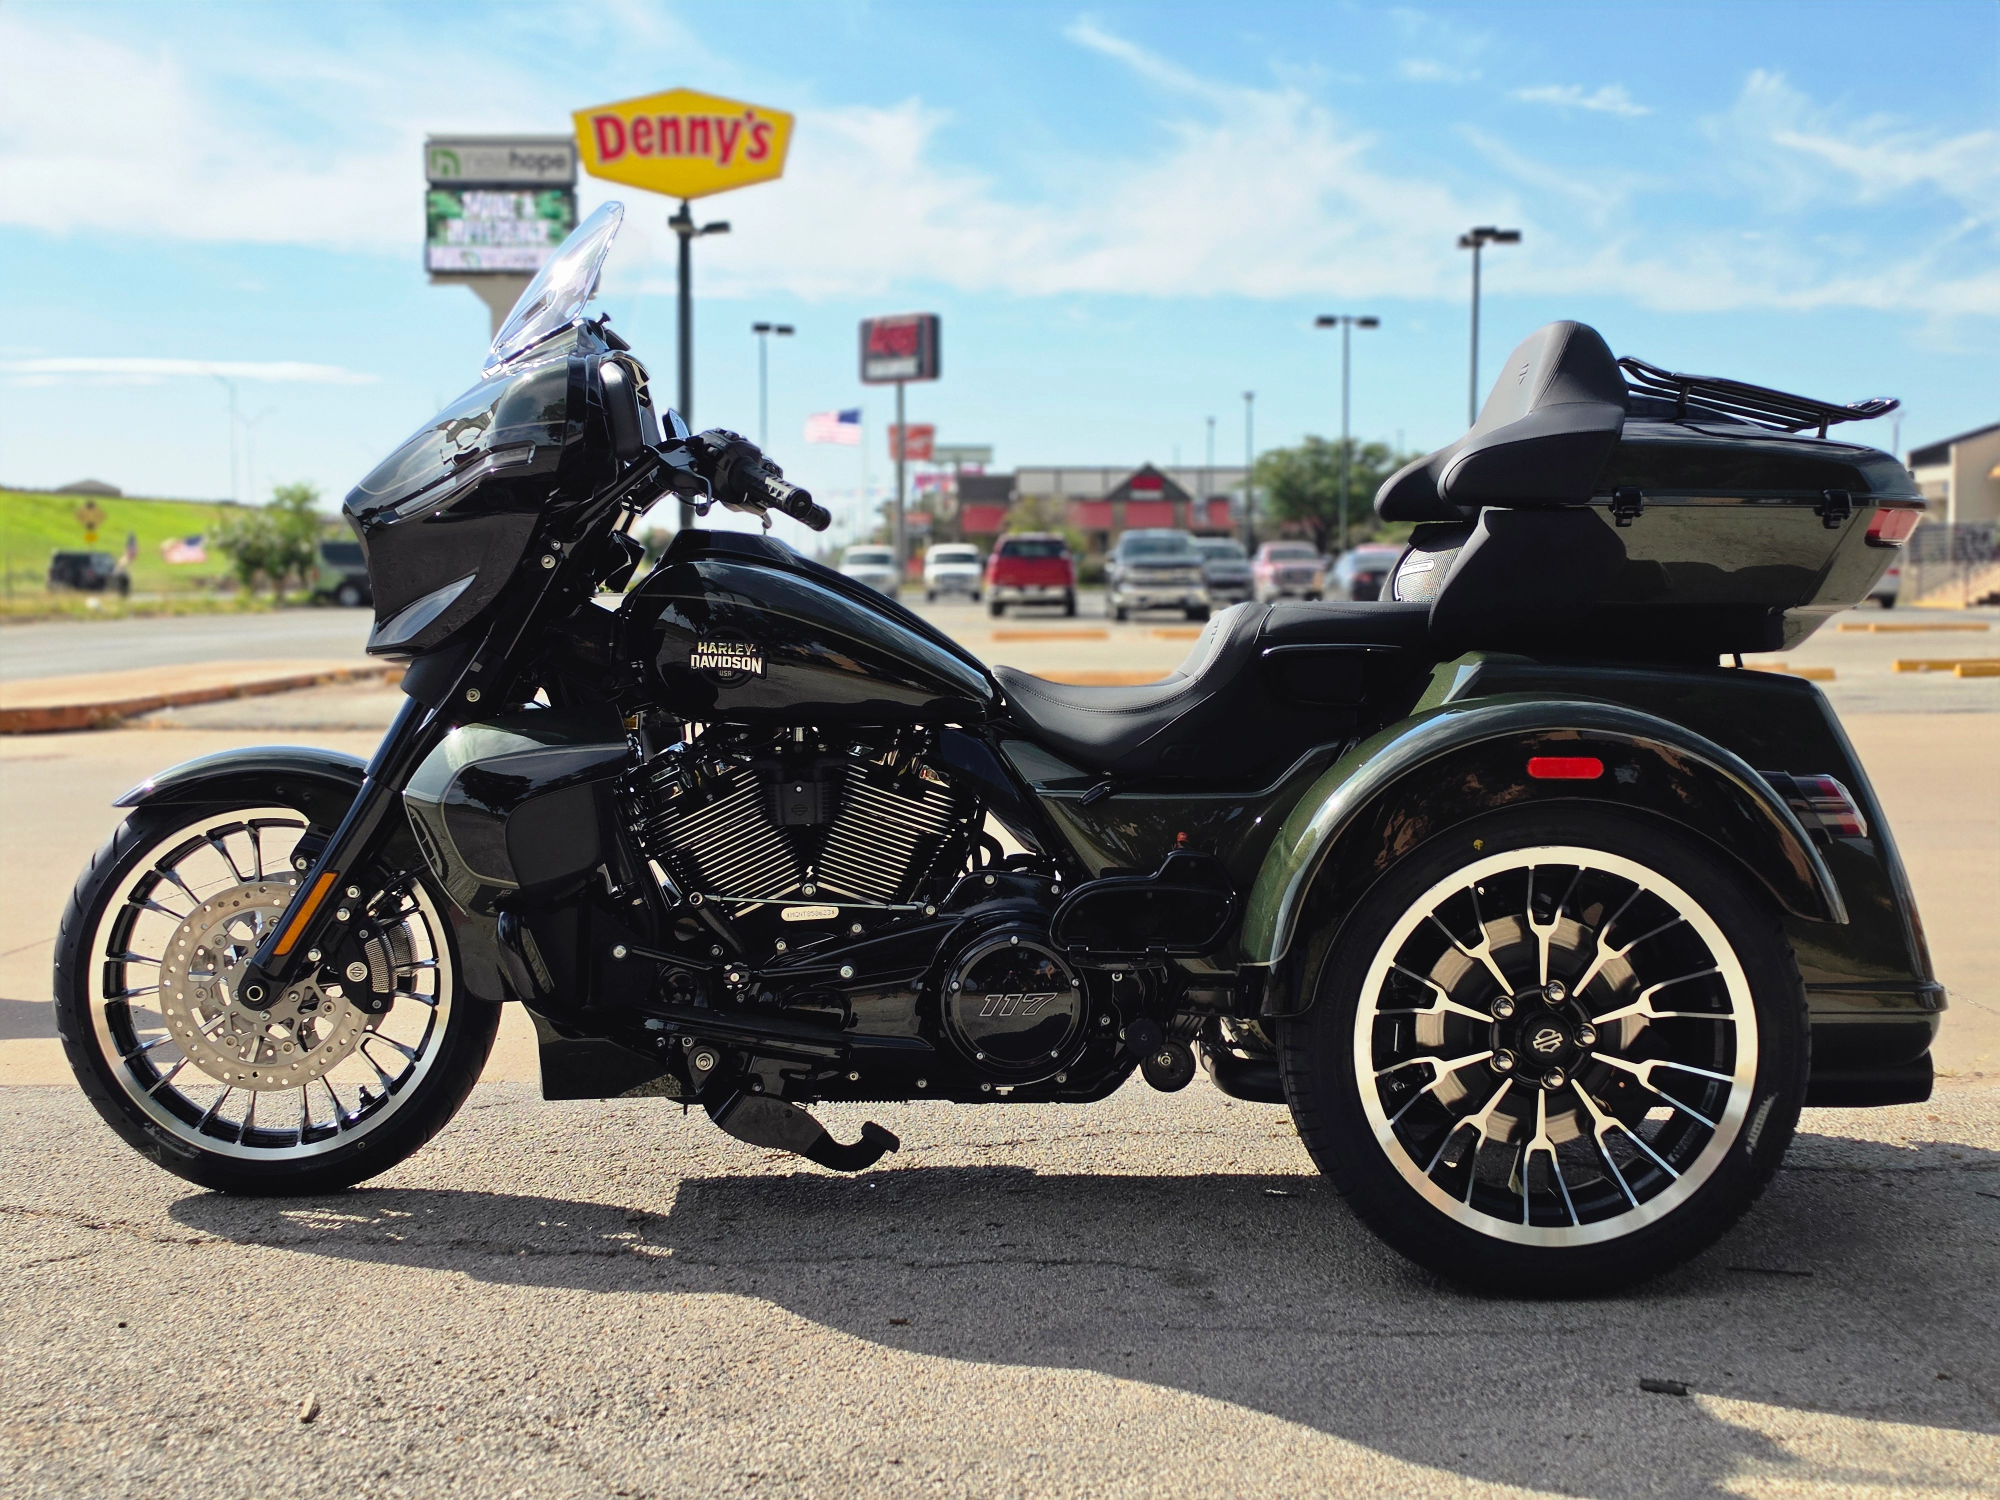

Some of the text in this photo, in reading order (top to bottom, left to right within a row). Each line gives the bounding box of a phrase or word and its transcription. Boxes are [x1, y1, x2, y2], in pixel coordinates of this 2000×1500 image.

[591, 110, 774, 168] Denny's
[509, 149, 567, 177] hope
[690, 654, 763, 675] DAVIDSON
[719, 669, 732, 677] USA
[979, 992, 1058, 1017] 117
